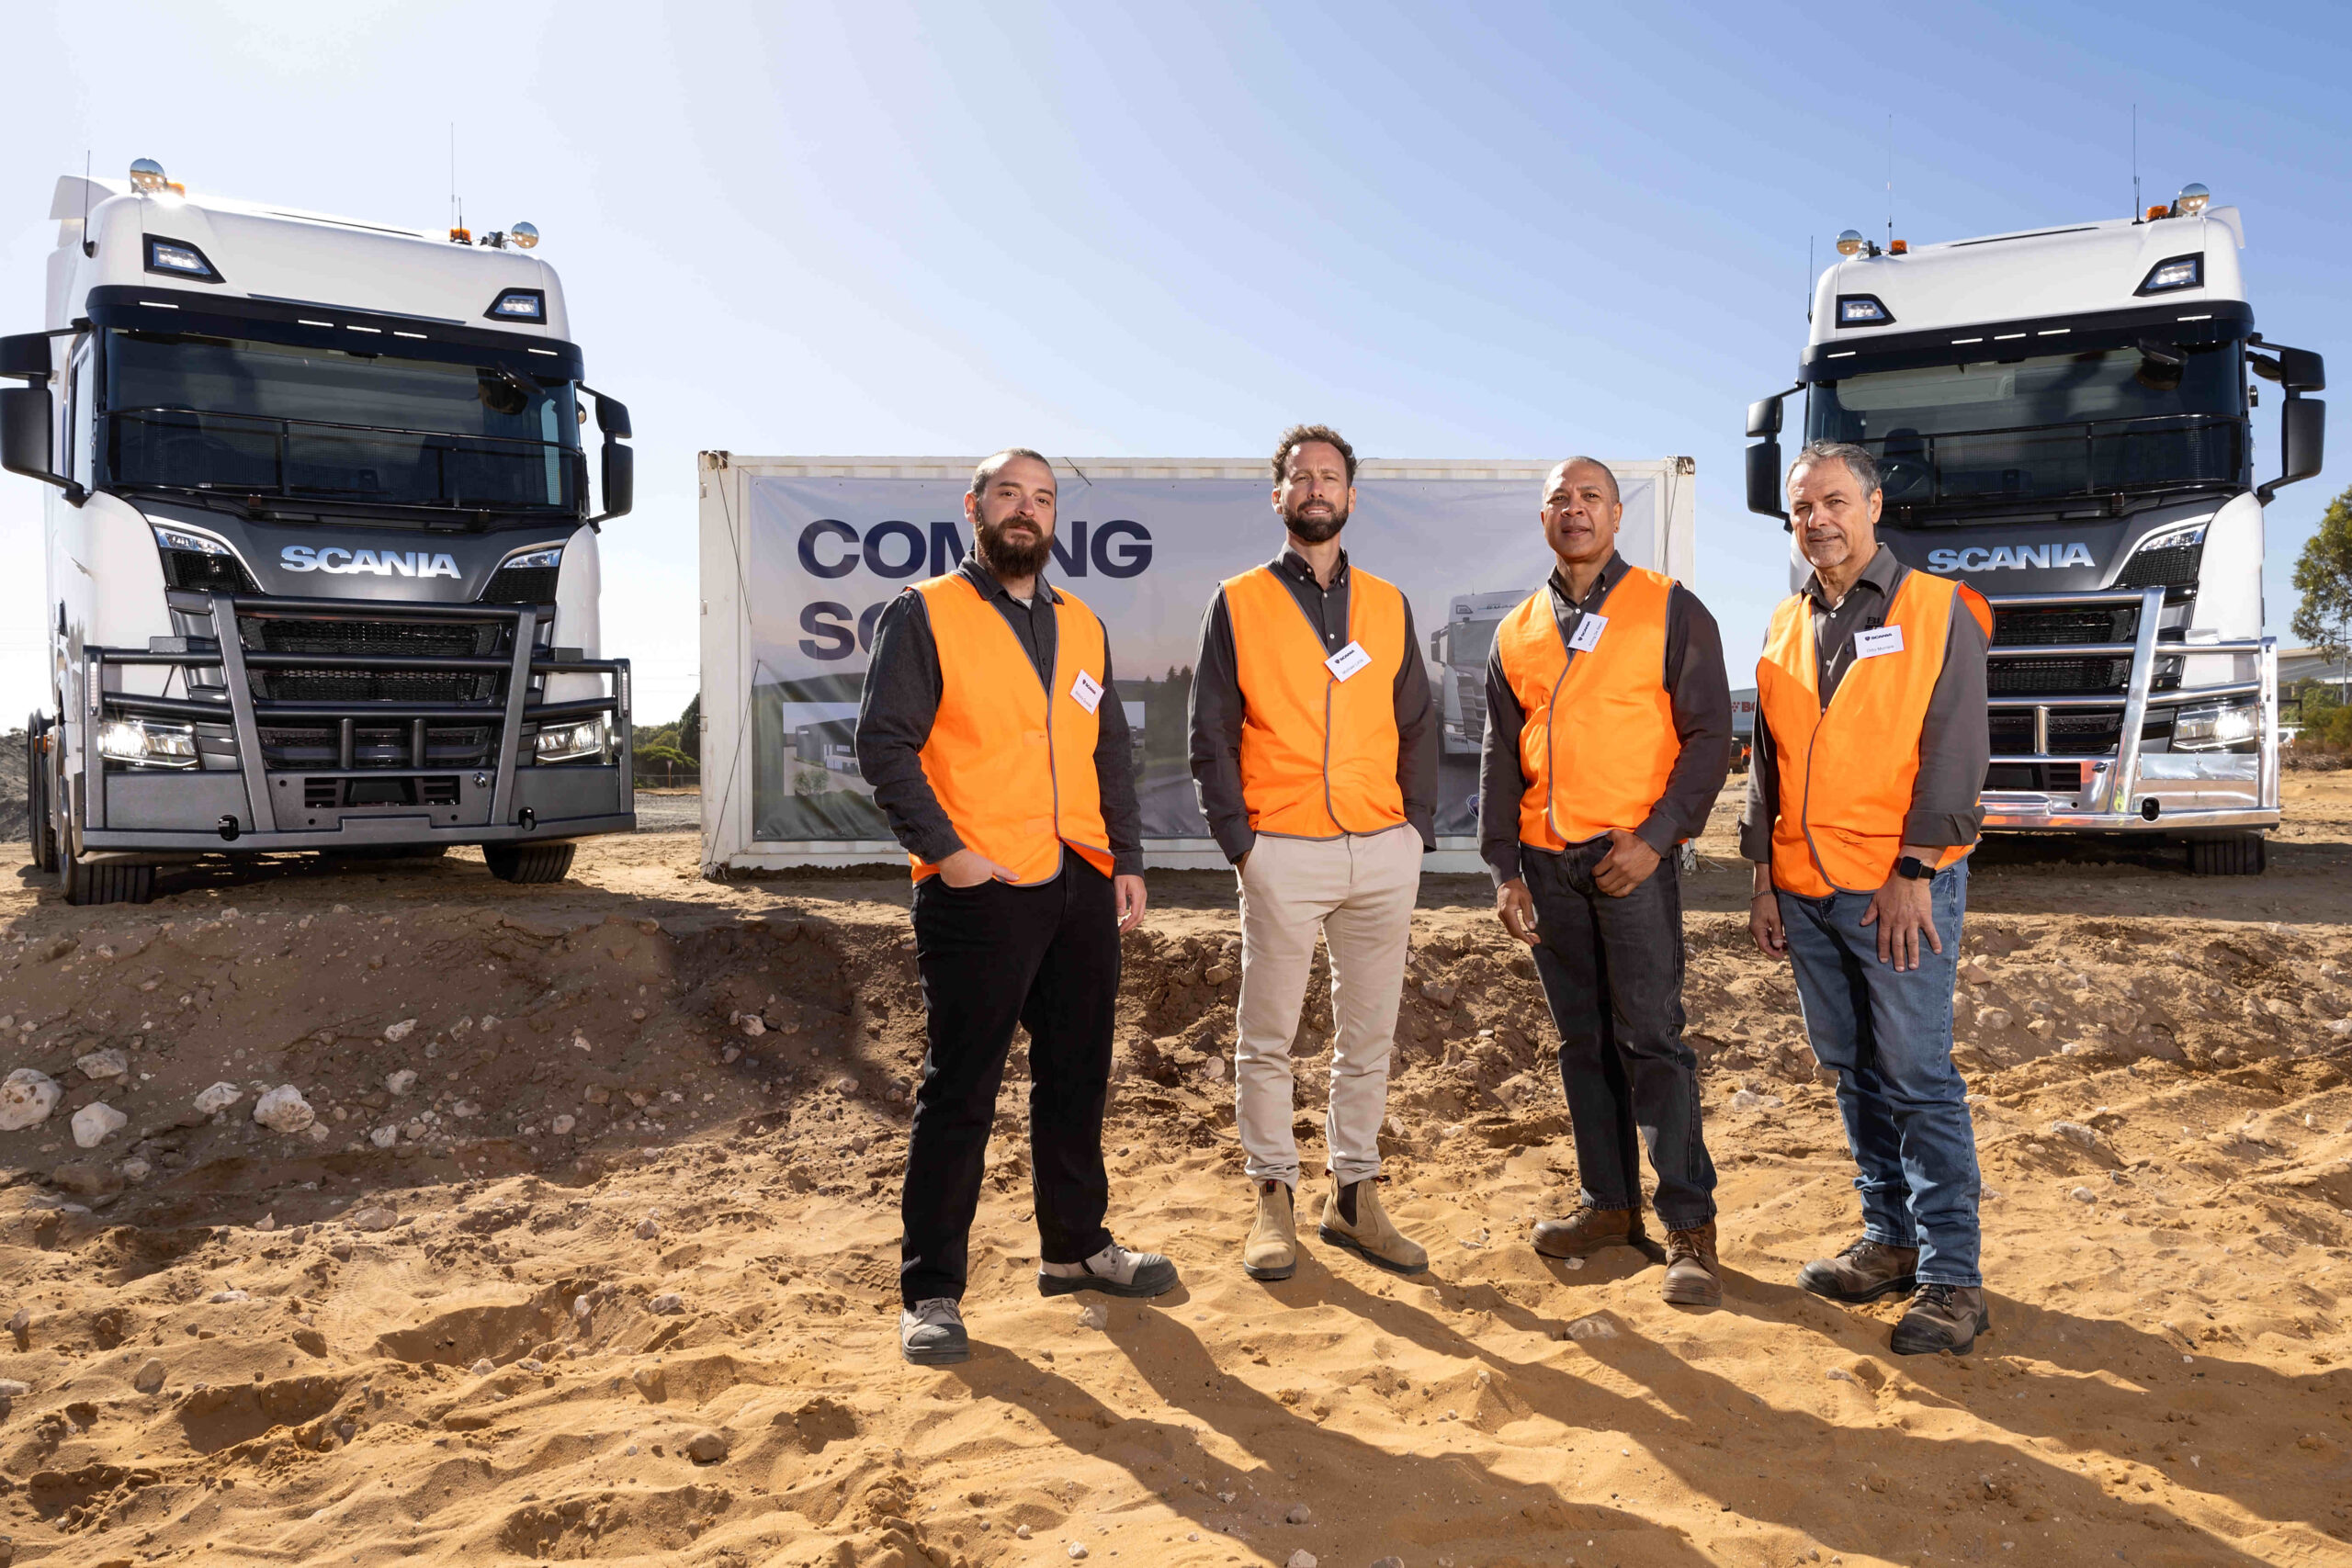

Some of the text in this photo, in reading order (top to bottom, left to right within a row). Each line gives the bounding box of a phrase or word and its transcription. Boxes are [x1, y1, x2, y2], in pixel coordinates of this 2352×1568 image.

[280, 545, 462, 580] SCANIA
[797, 519, 1153, 579] COMNG
[1927, 542, 2096, 574] SCANIA
